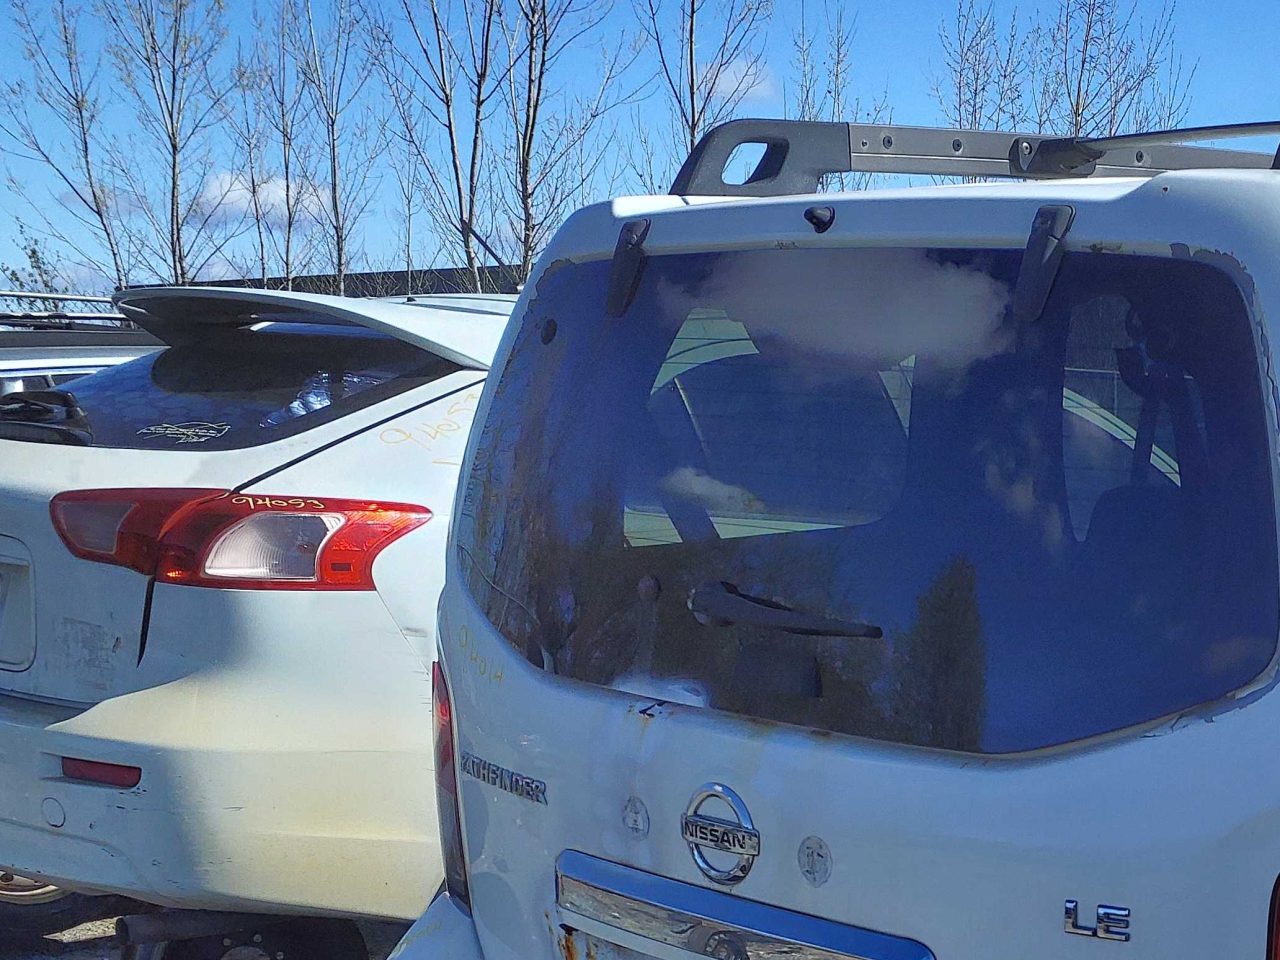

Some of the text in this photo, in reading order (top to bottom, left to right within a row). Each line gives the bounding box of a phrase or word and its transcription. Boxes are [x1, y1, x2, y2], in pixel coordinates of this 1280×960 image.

[232, 496, 325, 509] 94053
[460, 751, 548, 806] PATHFINDER
[684, 821, 746, 849] NISSAN
[1064, 899, 1131, 942] LE
